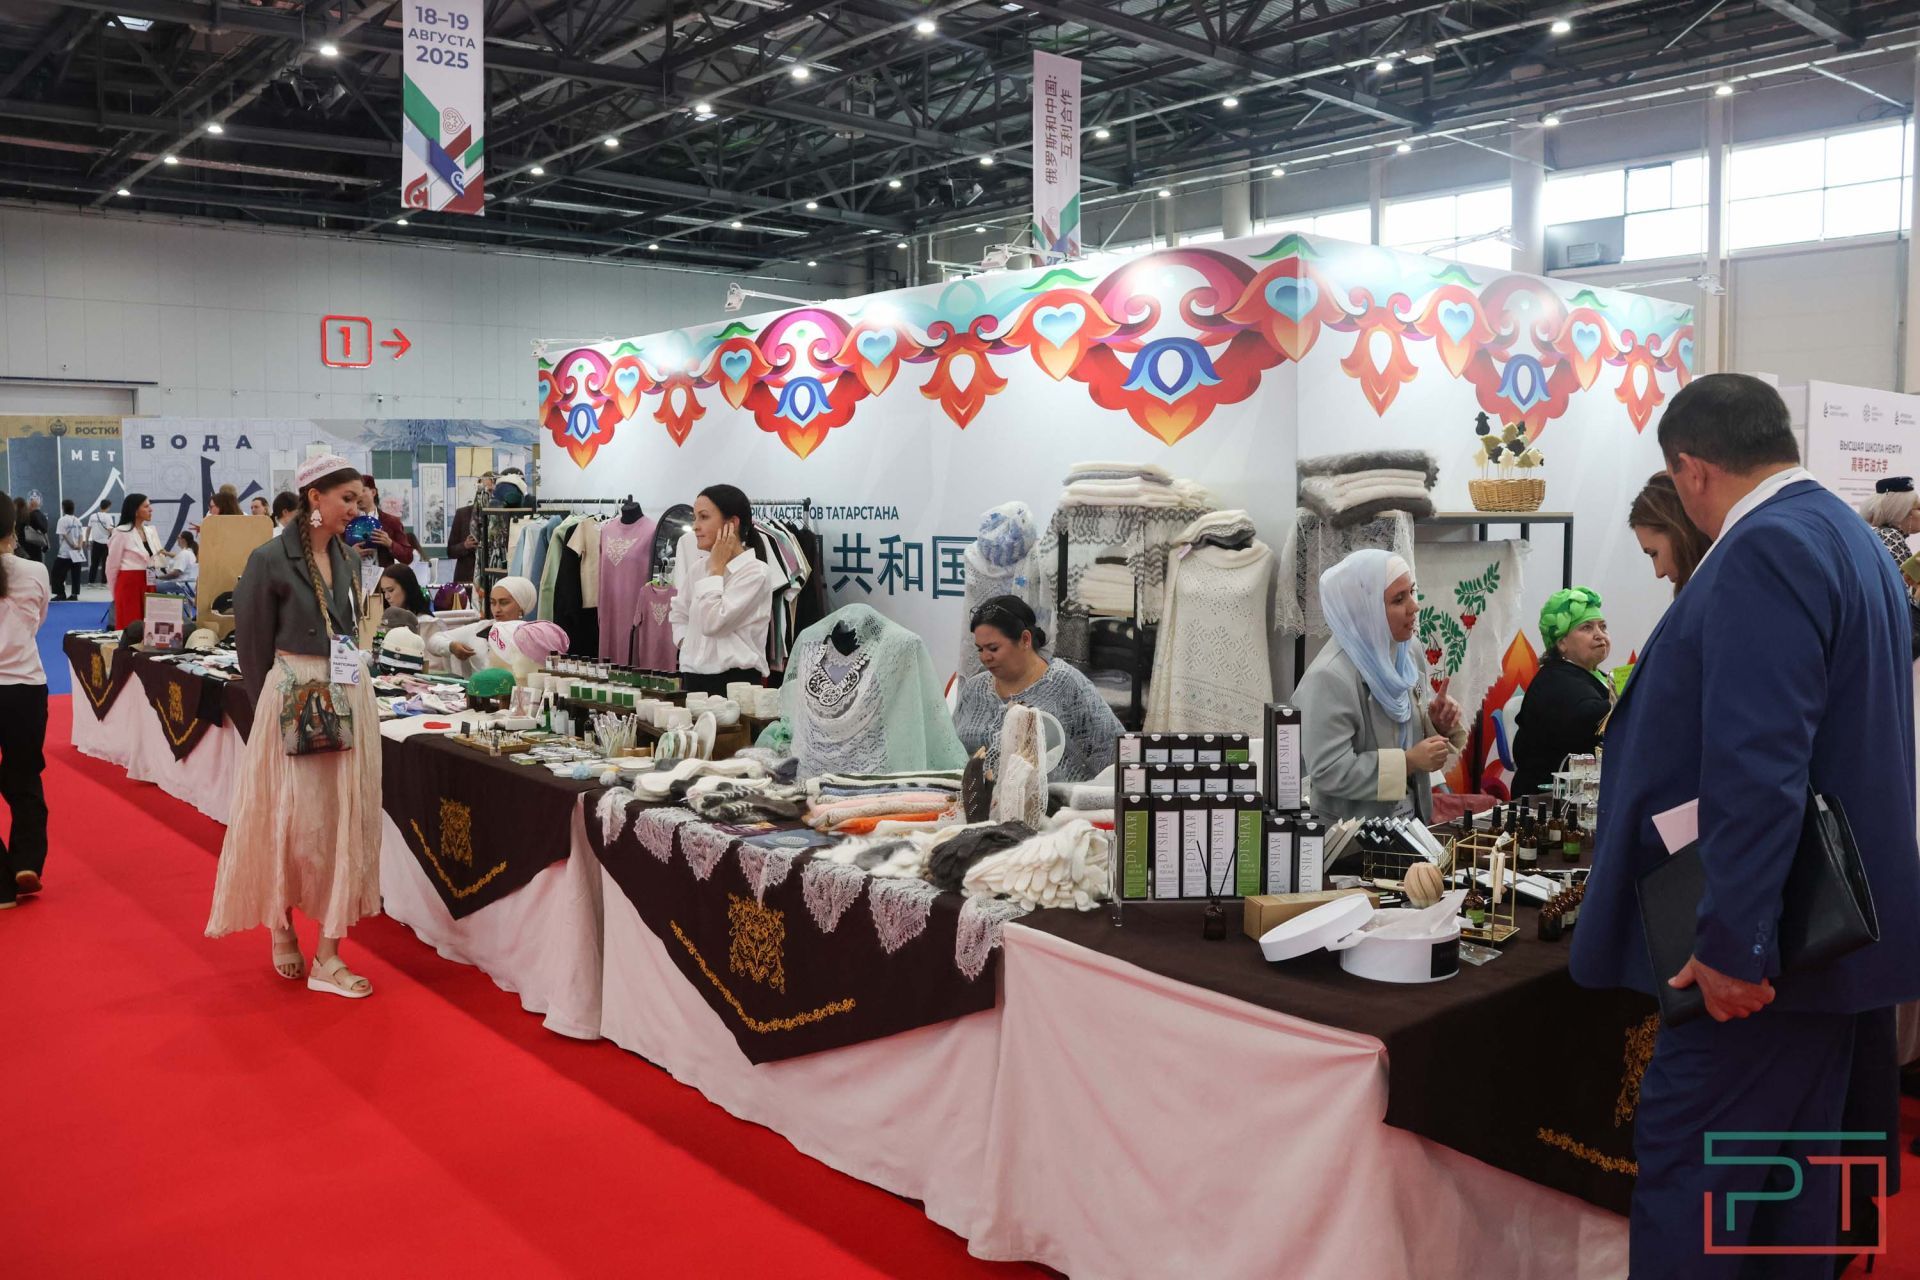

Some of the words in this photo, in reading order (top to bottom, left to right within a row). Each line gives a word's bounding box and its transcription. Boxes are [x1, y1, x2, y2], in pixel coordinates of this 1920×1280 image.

[408, 28, 476, 49] АВГУСТА
[416, 45, 469, 69] 2025
[338, 326, 351, 358] 1
[75, 426, 120, 435] РОСТКИ
[141, 434, 252, 452] ВОДА
[826, 506, 899, 520] ТАТАРСТАНА
[815, 532, 978, 599] 共和国
